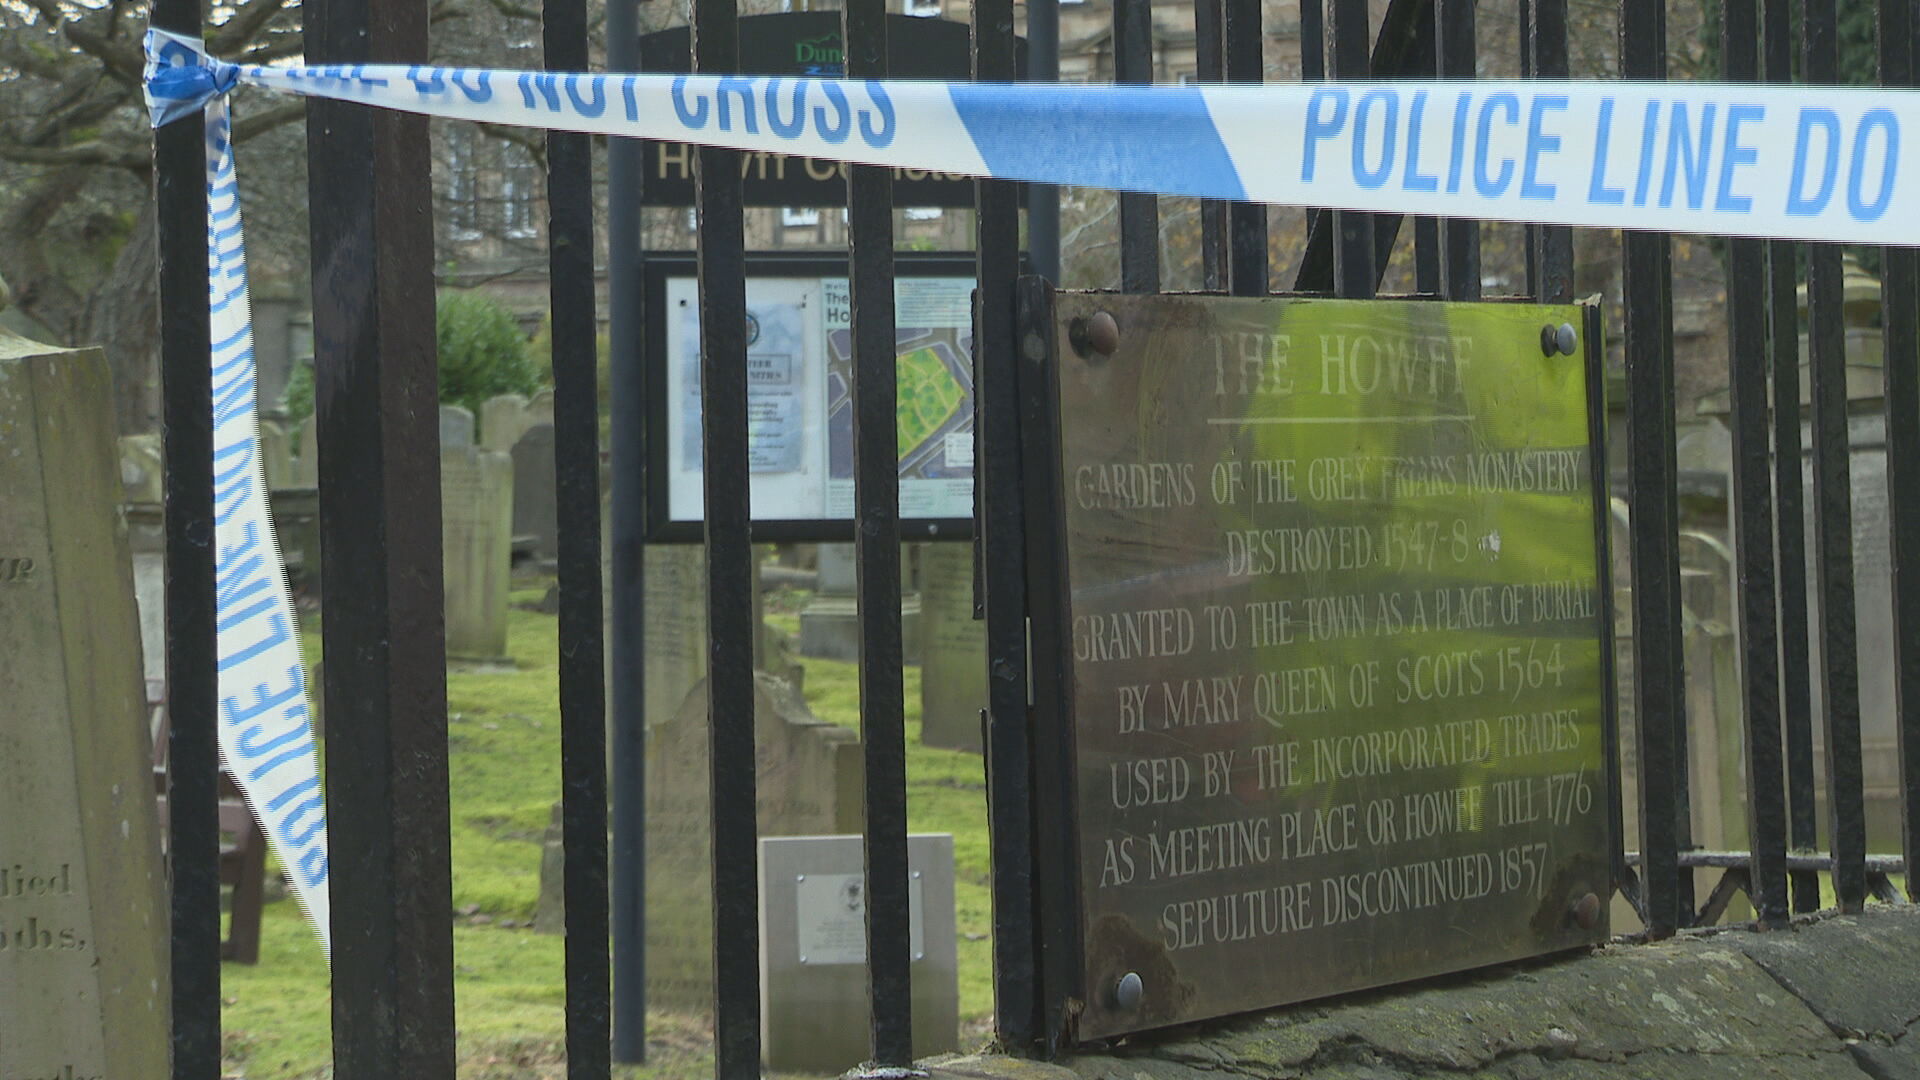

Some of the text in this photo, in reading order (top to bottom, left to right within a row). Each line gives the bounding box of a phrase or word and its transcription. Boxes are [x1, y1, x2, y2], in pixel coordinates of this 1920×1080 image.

[795, 43, 842, 62] Dun
[671, 76, 896, 149] CROSS
[1300, 85, 1900, 223] POLICE LINE DO
[1212, 334, 1473, 395] THE HOWFF
[1076, 463, 1196, 512] GARDENS
[1211, 460, 1242, 505] OF
[1251, 459, 1297, 503] THE
[1308, 456, 1372, 502] GREY
[1467, 451, 1582, 494] MONASTERY
[1074, 580, 1596, 663] GRANTED TO THE TOWN AS A PLACE OF BURIAL
[1118, 638, 1565, 734] BY MARY QUEEN OF SCOTS 1564
[1110, 709, 1580, 808] USED BY THE INCORPORATED TRADES
[1100, 762, 1593, 889] AS MEETING PLACE OR HOWFF TILL 1776
[1161, 842, 1547, 951] SEPULTURE DISCONTINUED 1857
